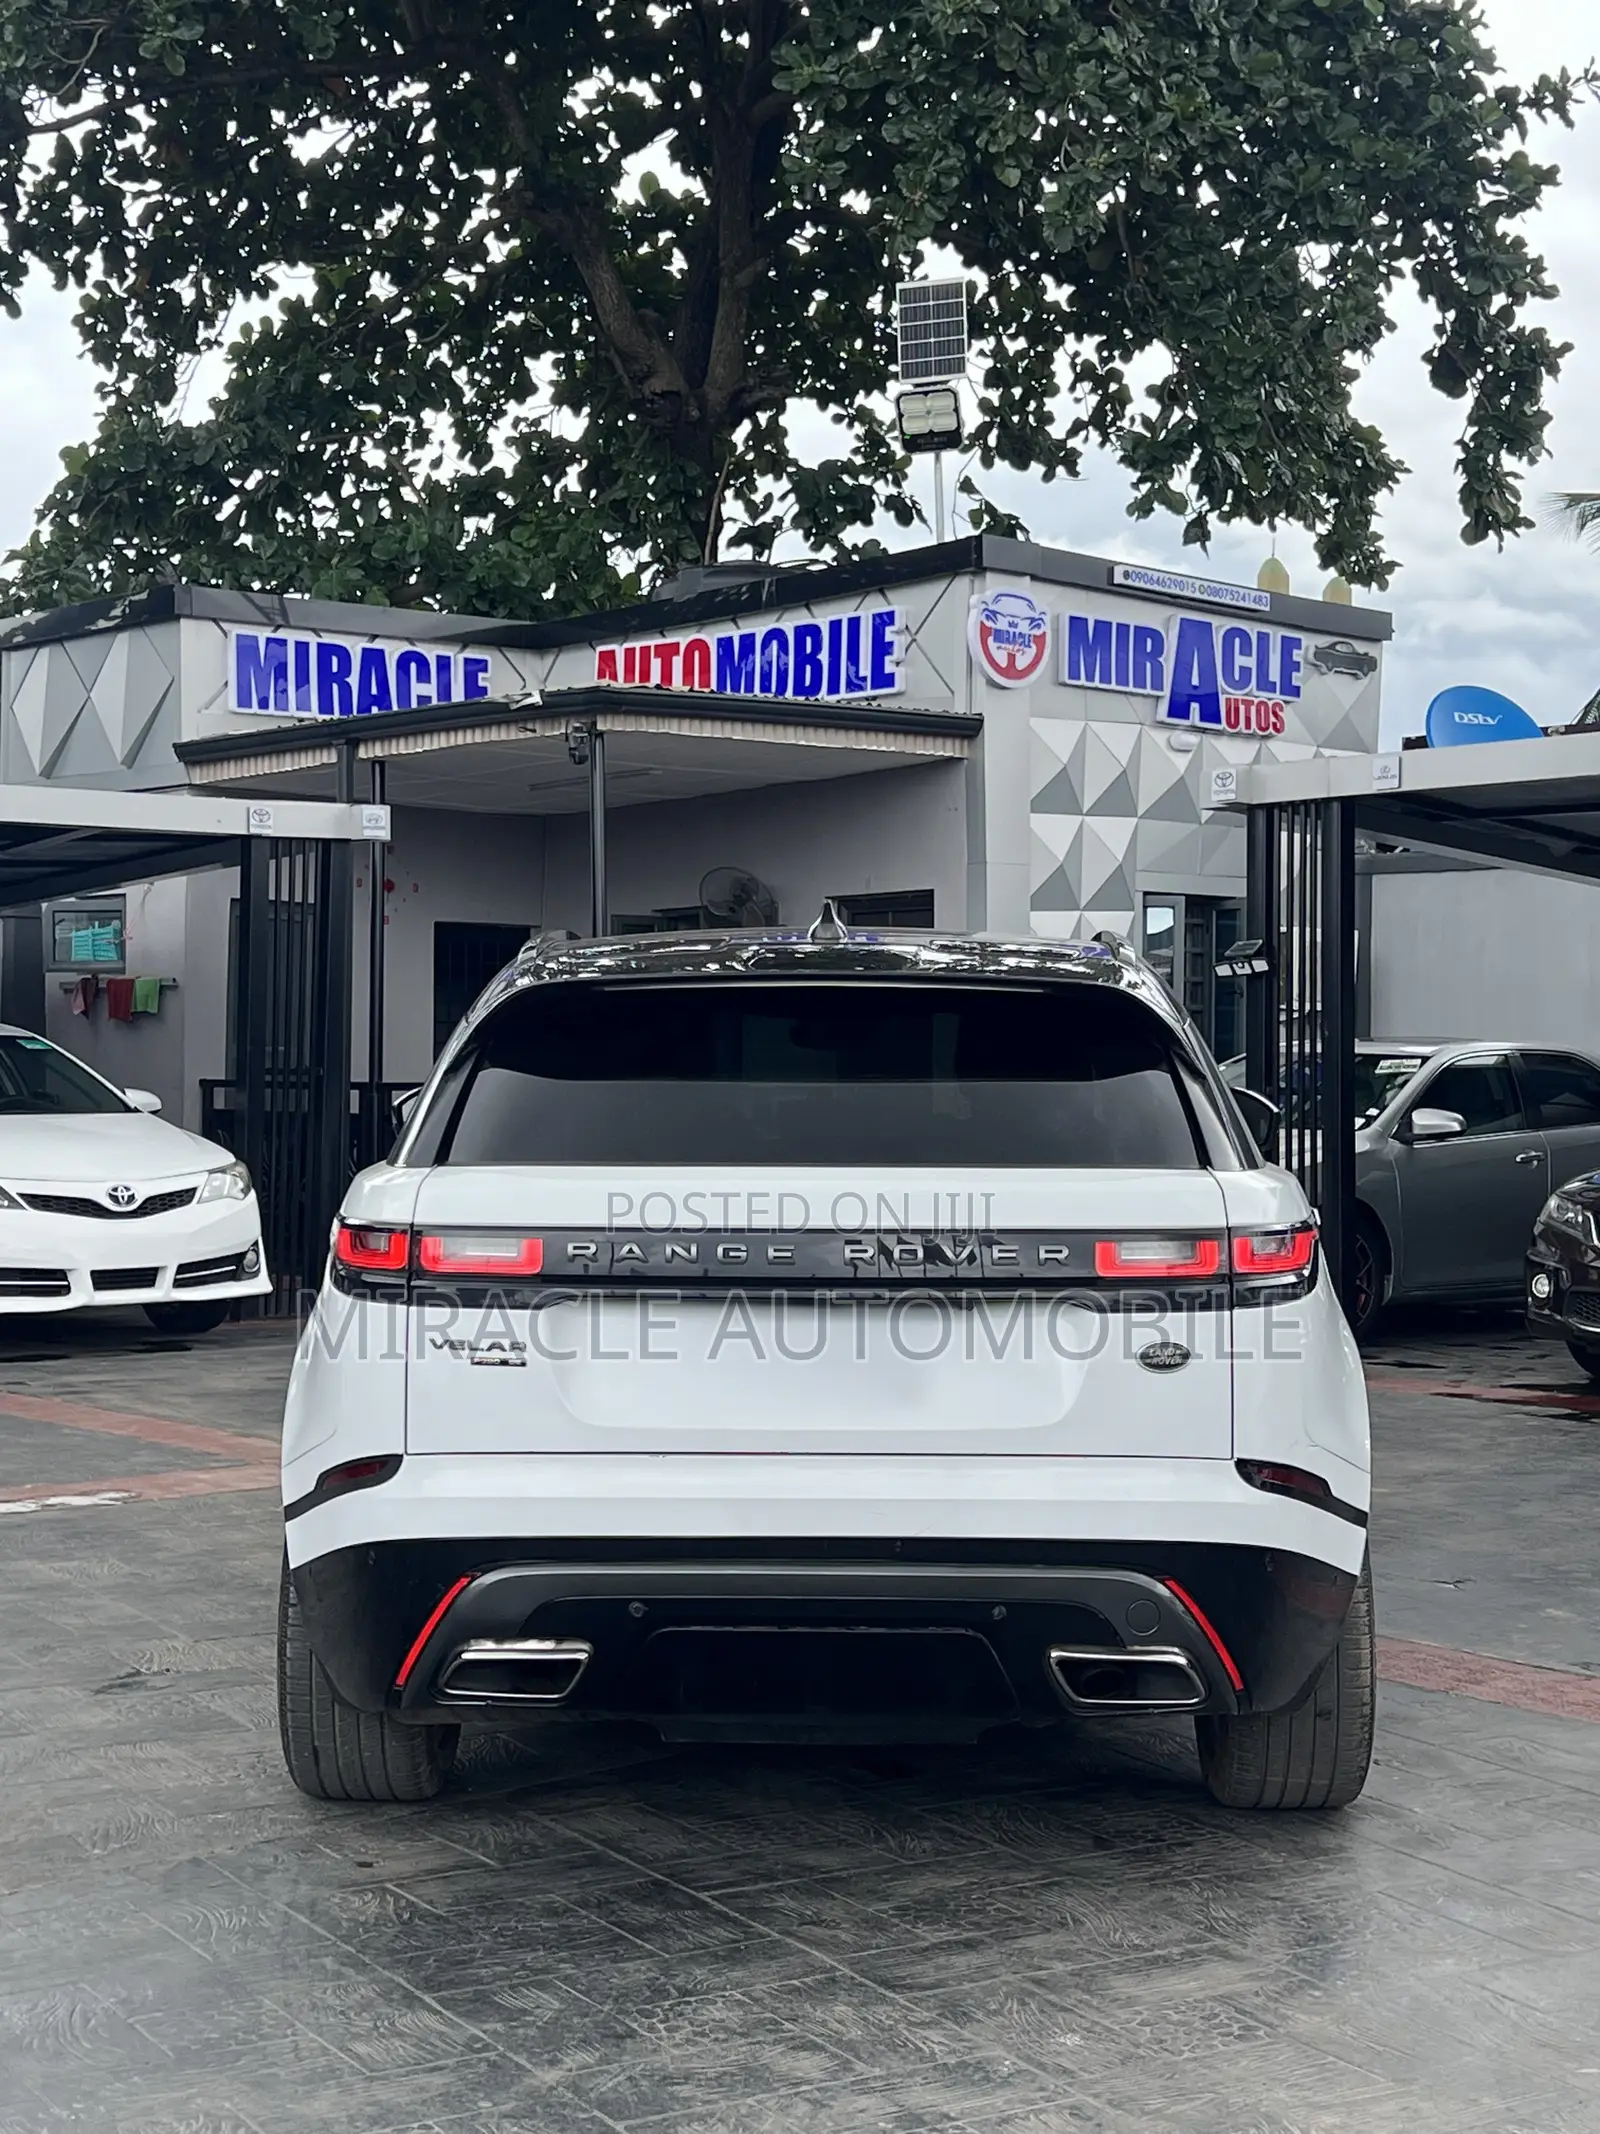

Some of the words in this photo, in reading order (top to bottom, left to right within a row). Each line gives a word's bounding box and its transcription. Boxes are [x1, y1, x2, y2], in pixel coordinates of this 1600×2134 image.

[992, 628, 1033, 649] MIRACLE
[236, 633, 489, 716] MIRACLE
[597, 609, 896, 697] AUTOMOBILE
[1067, 615, 1302, 725] MIRACLE
[567, 1242, 797, 1265] RANGE
[843, 1244, 1071, 1267] ROVER
[429, 1338, 527, 1353] VELAR
